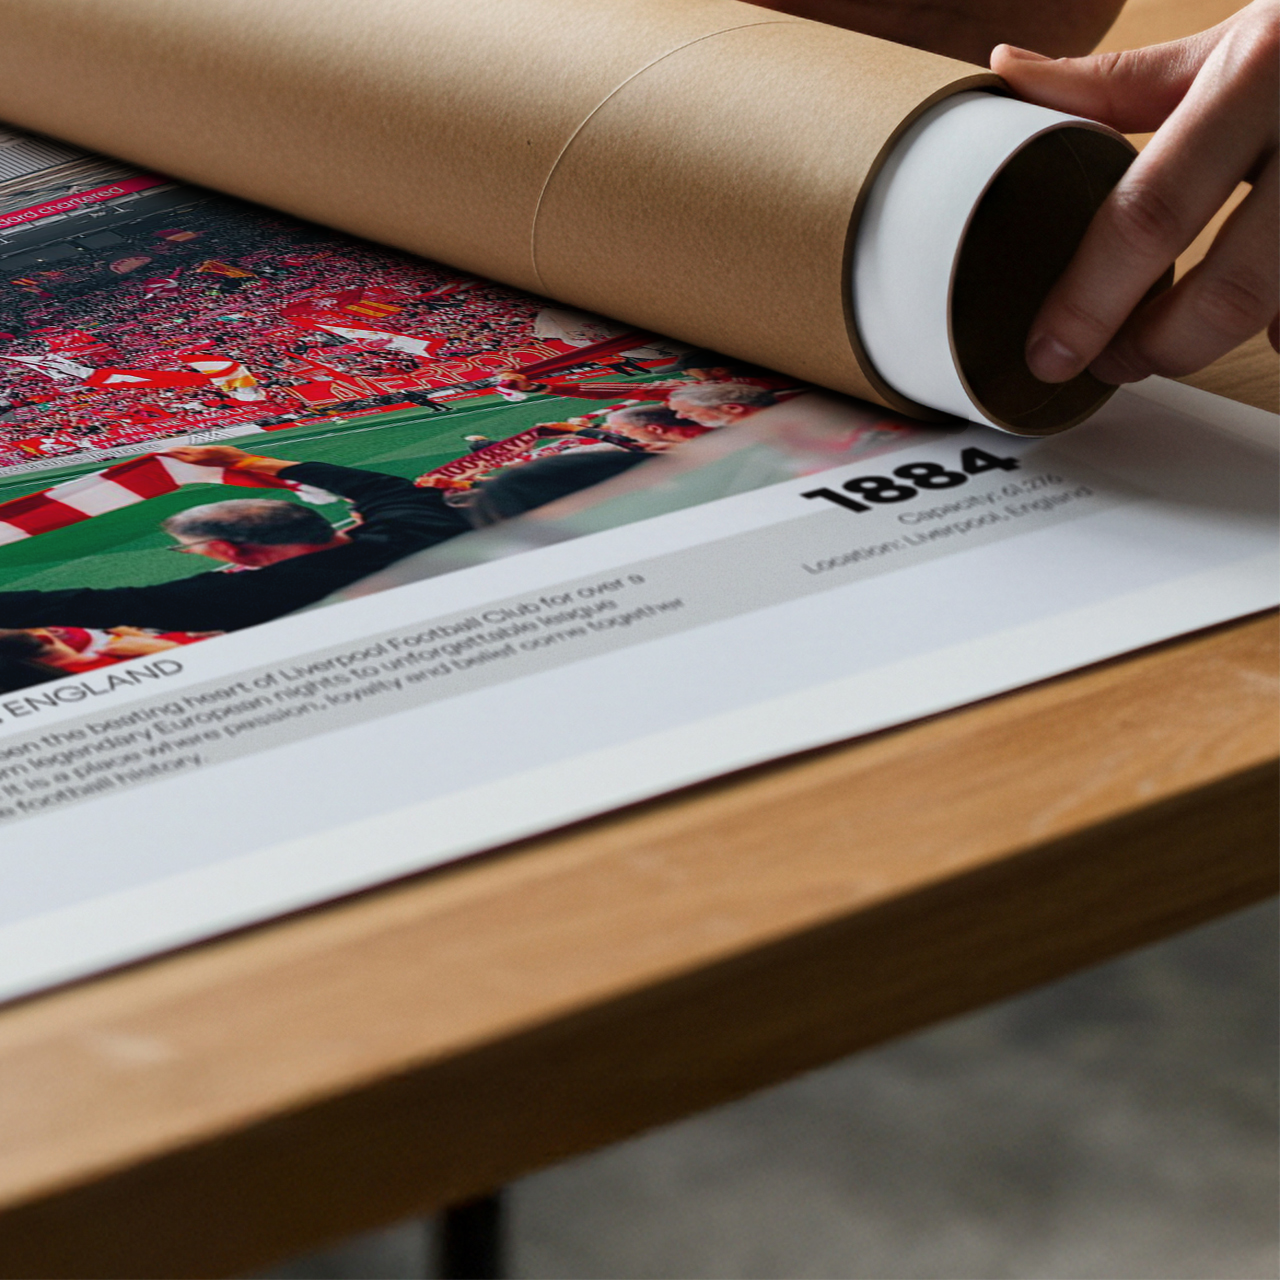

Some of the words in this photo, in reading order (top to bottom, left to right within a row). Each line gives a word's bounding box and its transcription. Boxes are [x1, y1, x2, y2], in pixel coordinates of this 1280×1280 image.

[800, 446, 1022, 513] 1884
[2, 660, 183, 717] ENGLAND
[39, 729, 88, 748] the
[85, 701, 186, 736] beating
[181, 681, 252, 709] heart
[252, 672, 279, 689] of
[278, 642, 389, 682] Liverpool
[386, 616, 484, 651] Football
[481, 602, 542, 624] Club
[538, 592, 574, 609] for
[576, 578, 625, 599] over
[627, 574, 646, 585] a
